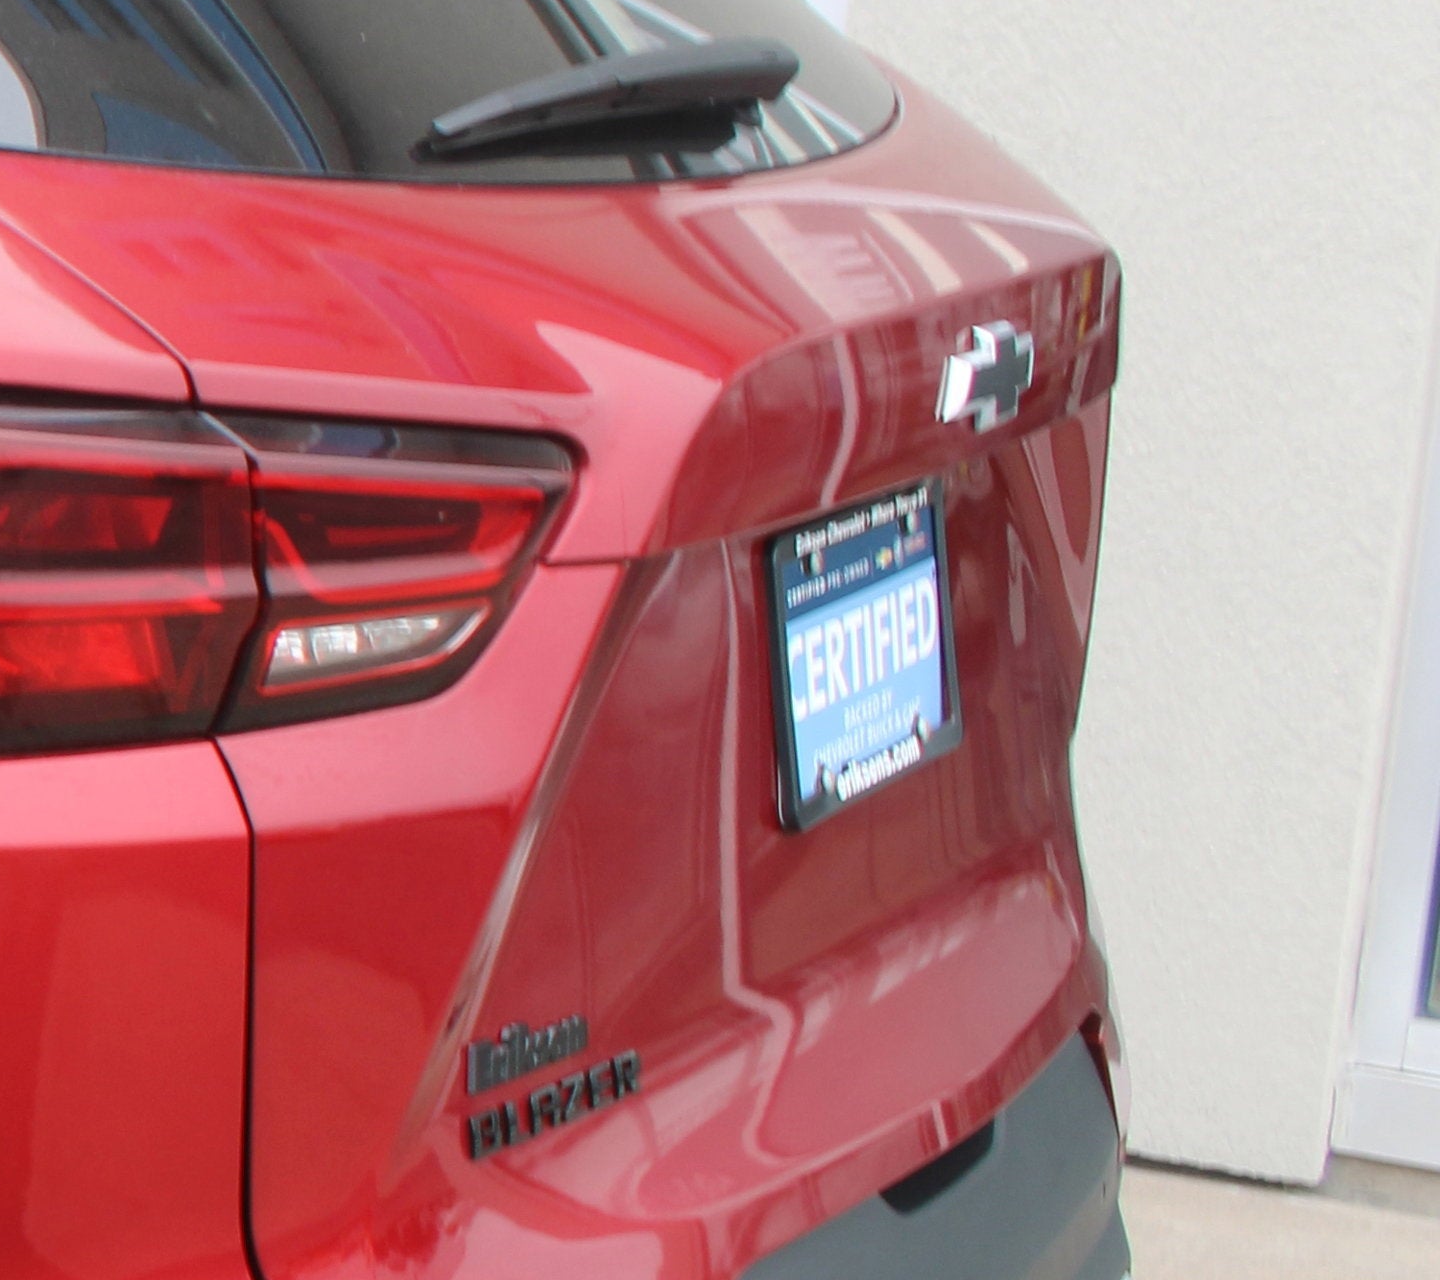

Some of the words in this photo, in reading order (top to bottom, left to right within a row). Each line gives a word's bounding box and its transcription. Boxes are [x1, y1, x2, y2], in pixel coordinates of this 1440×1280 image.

[787, 575, 938, 723] CERTIFIED
[836, 734, 921, 802] eriksens.com
[469, 1048, 642, 1161] BLAZER
